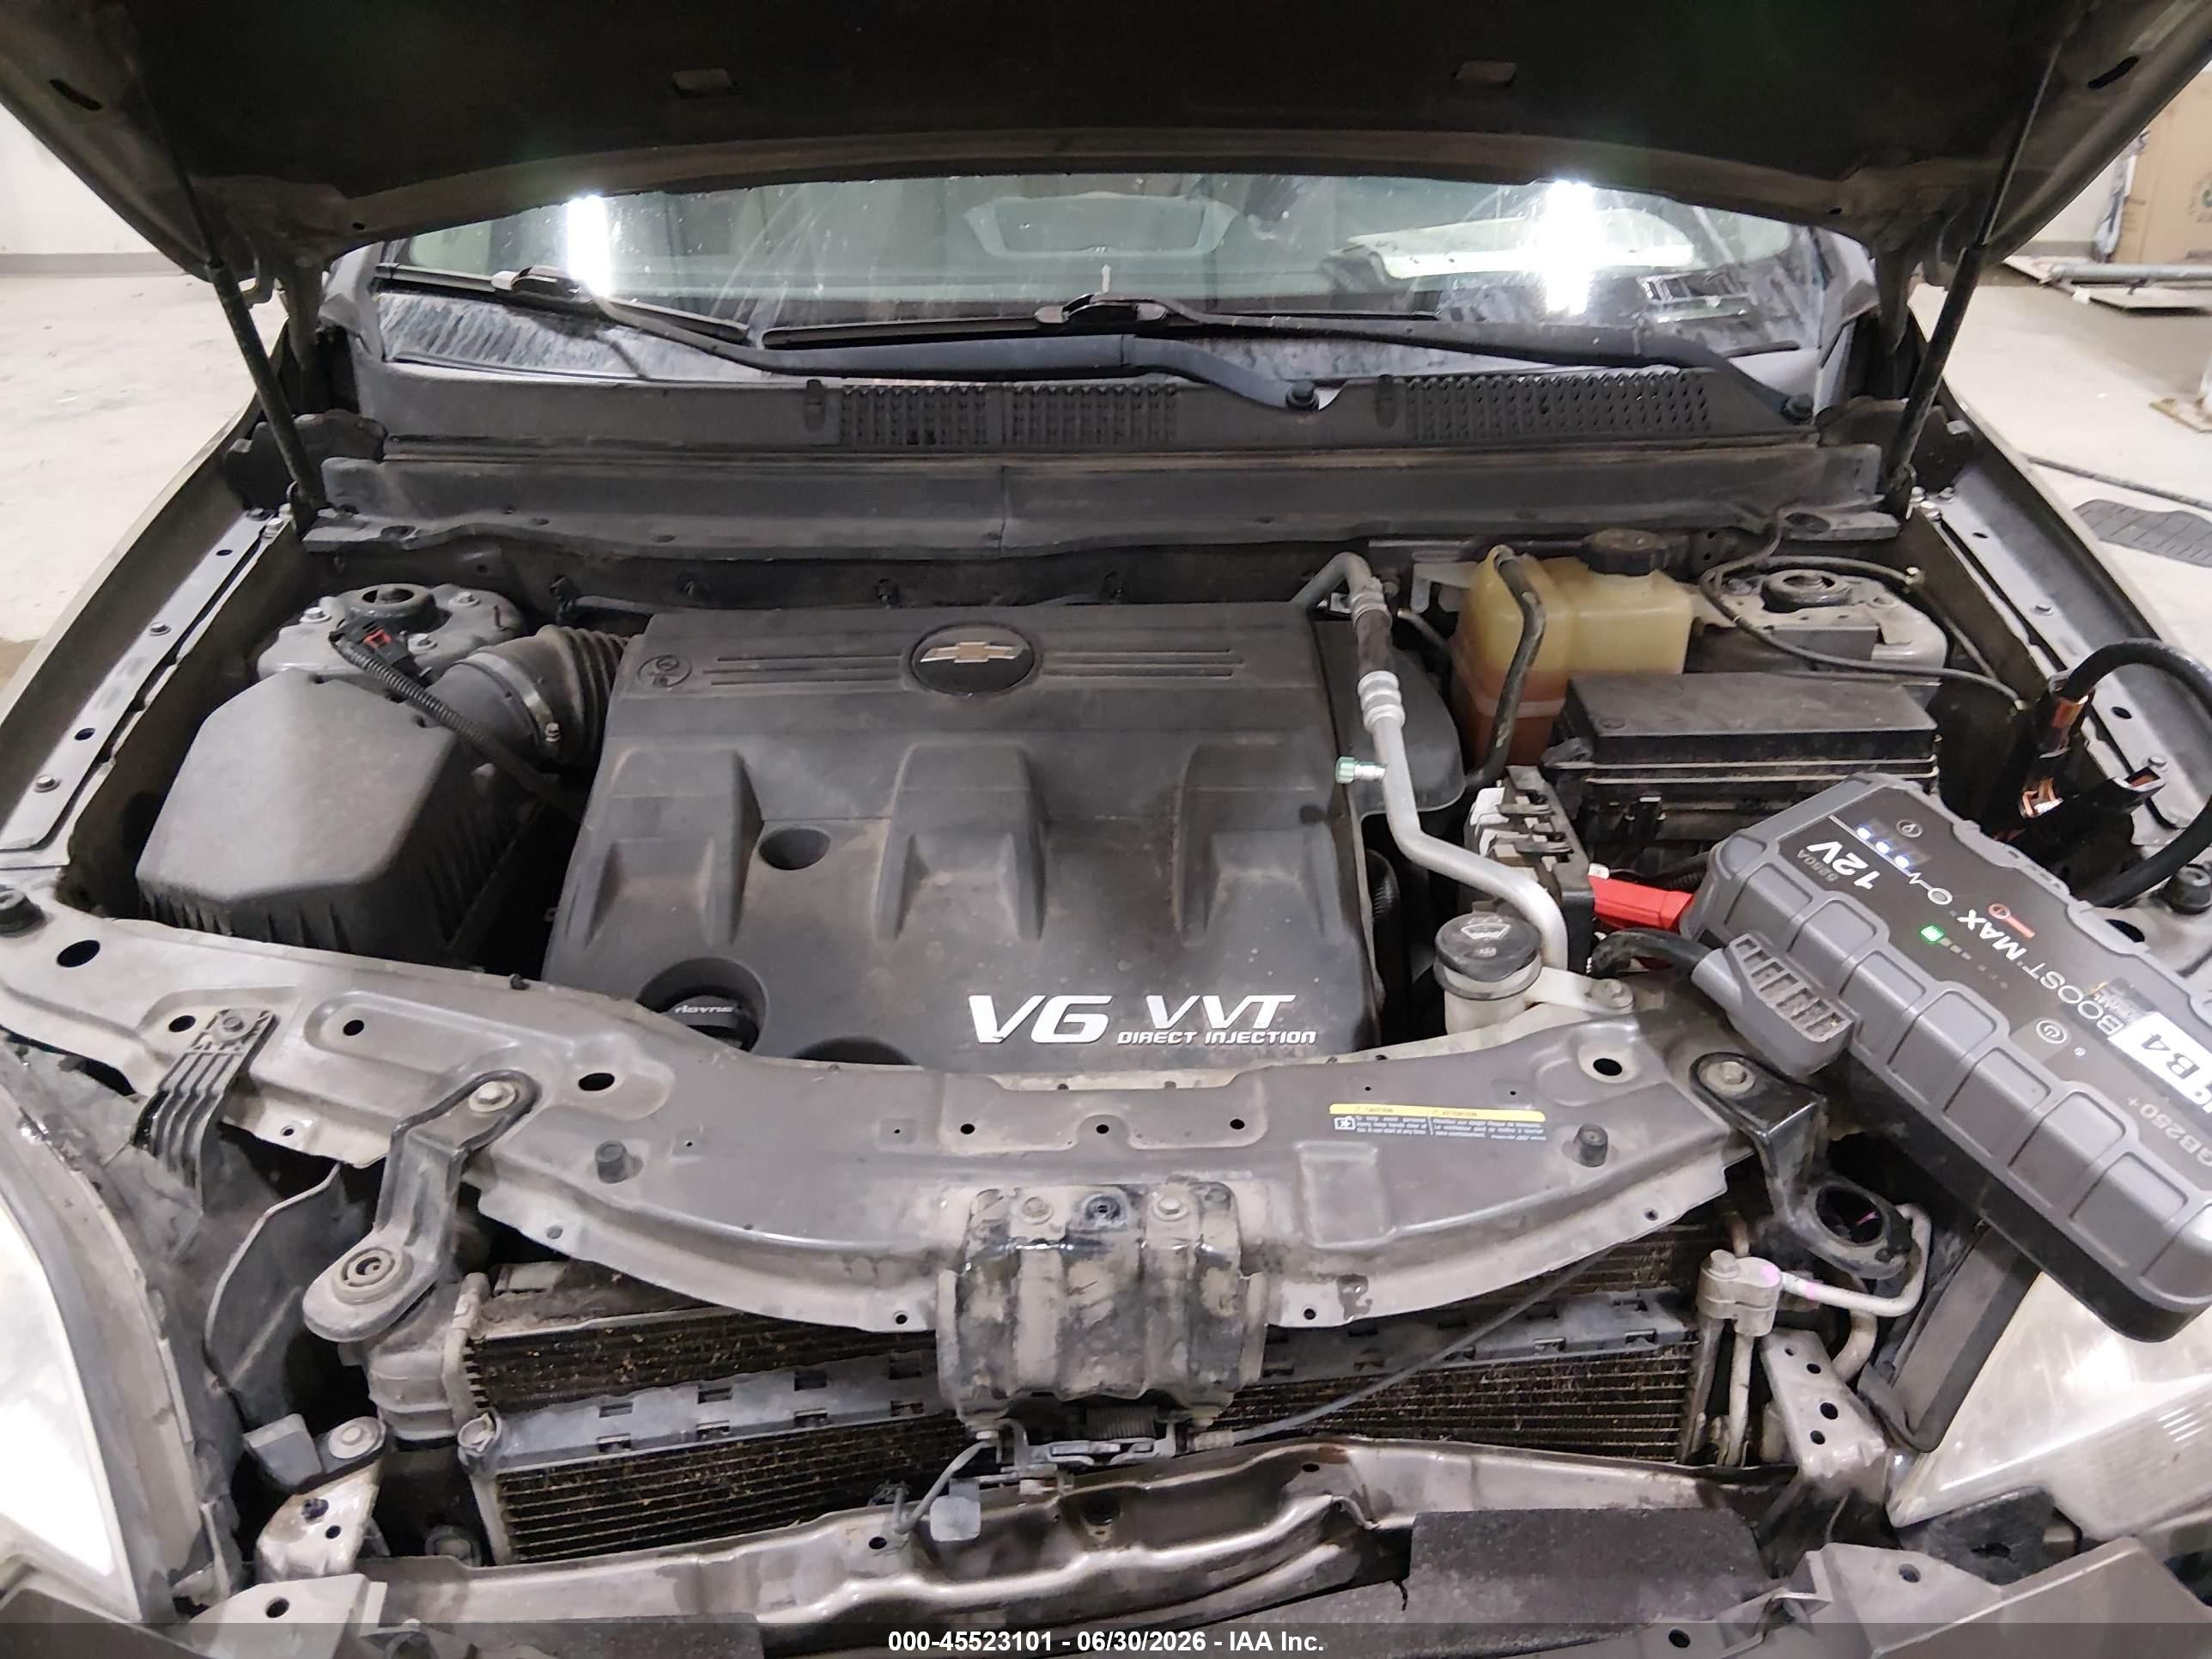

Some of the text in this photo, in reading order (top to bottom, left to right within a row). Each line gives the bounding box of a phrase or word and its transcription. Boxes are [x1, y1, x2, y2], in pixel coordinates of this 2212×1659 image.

[1806, 841, 1881, 890] 12V
[1958, 908, 2027, 961] MAX
[969, 994, 1297, 1044] V6 VVT
[2021, 961, 2125, 1035] BOOST
[1117, 1030, 1317, 1046] DIRECT INJECTION
[2142, 1033, 2200, 1079] B4
